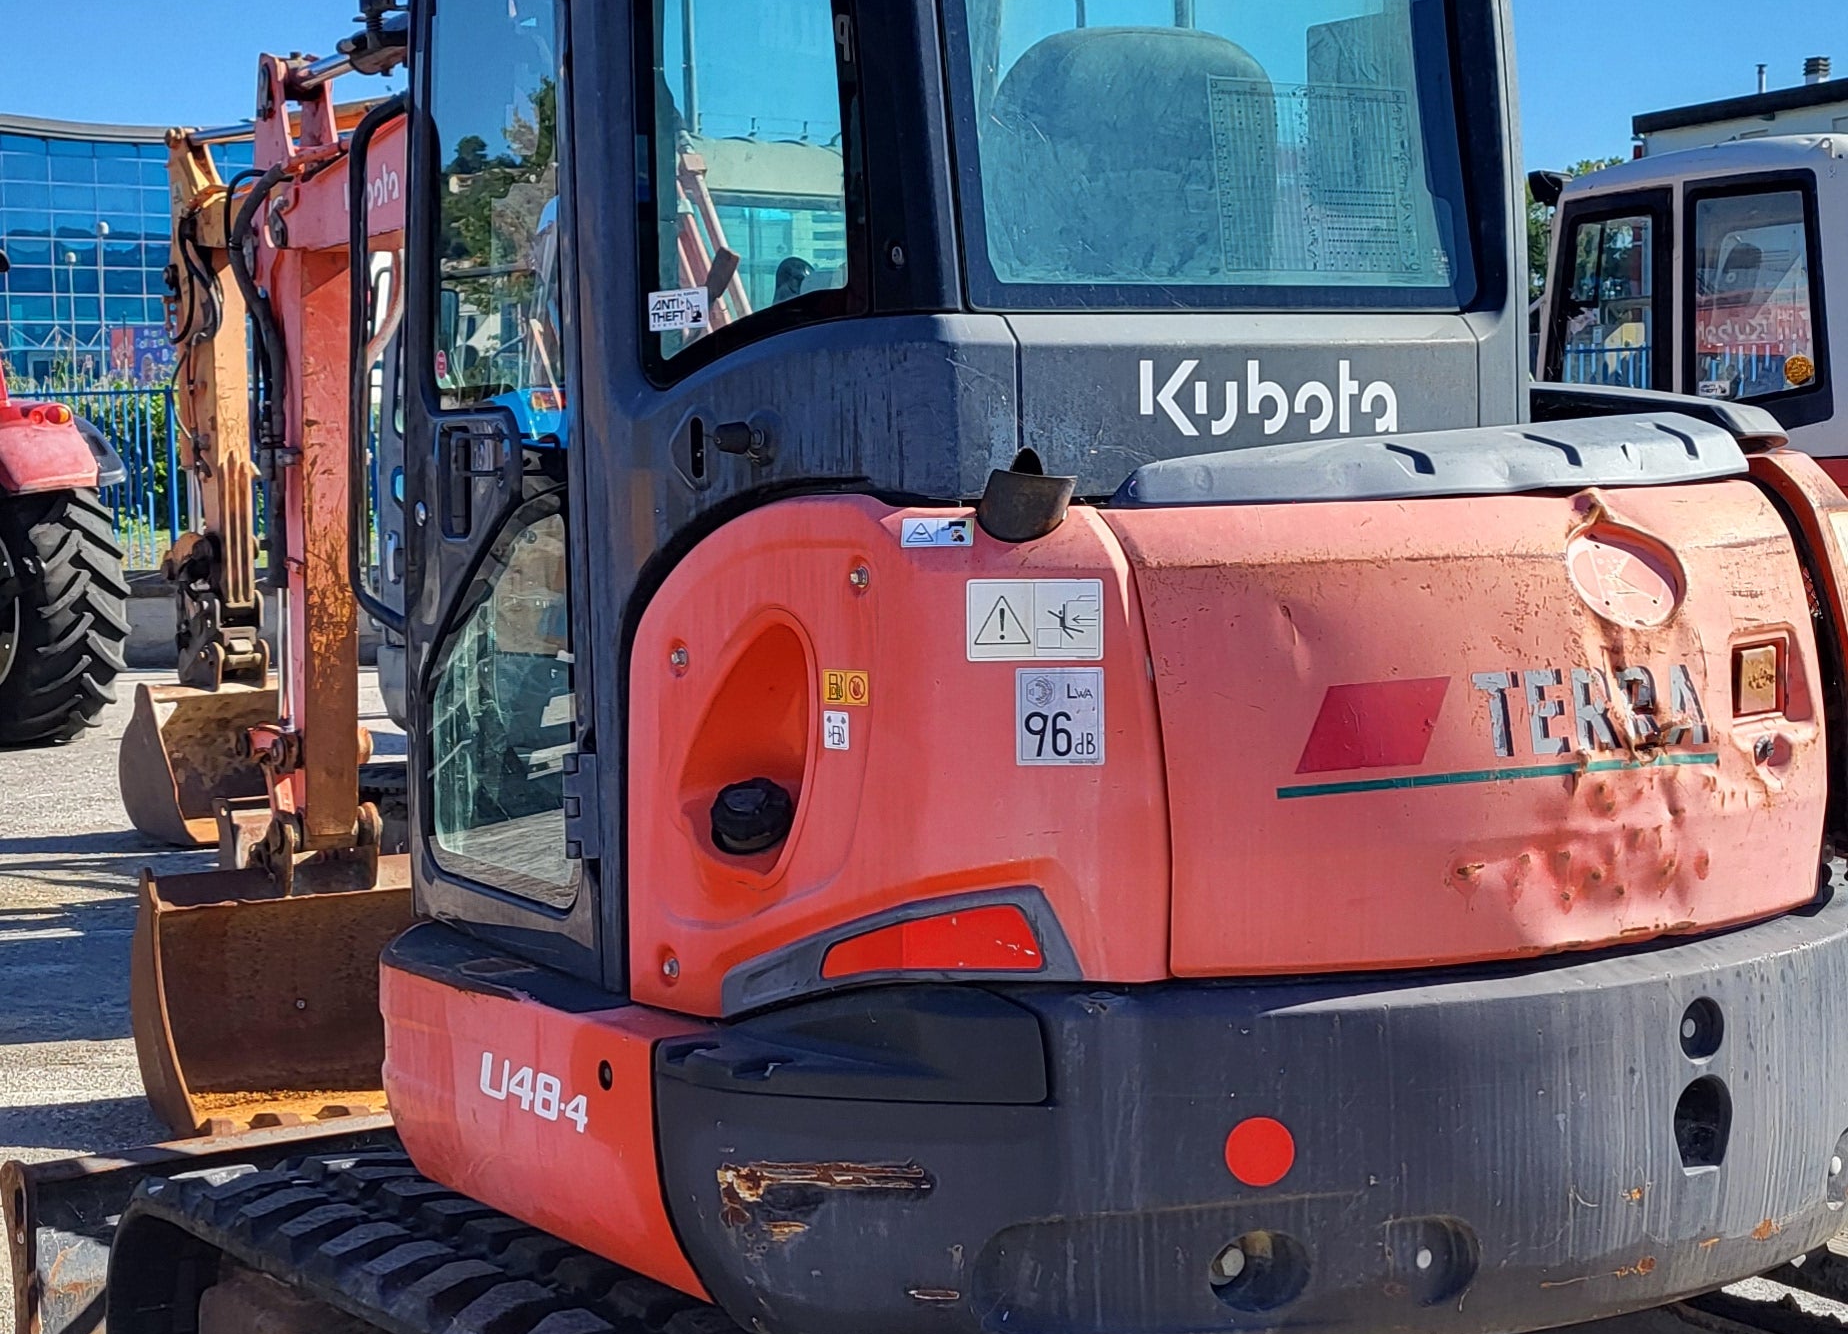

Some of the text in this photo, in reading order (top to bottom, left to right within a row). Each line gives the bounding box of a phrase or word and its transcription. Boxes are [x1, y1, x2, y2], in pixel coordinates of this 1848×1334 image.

[651, 298, 680, 311] ANTI
[651, 310, 685, 323] THEFT
[1140, 360, 1397, 436] Kubota
[1024, 711, 1096, 757] 96 dB
[1471, 665, 1710, 757] TERRA
